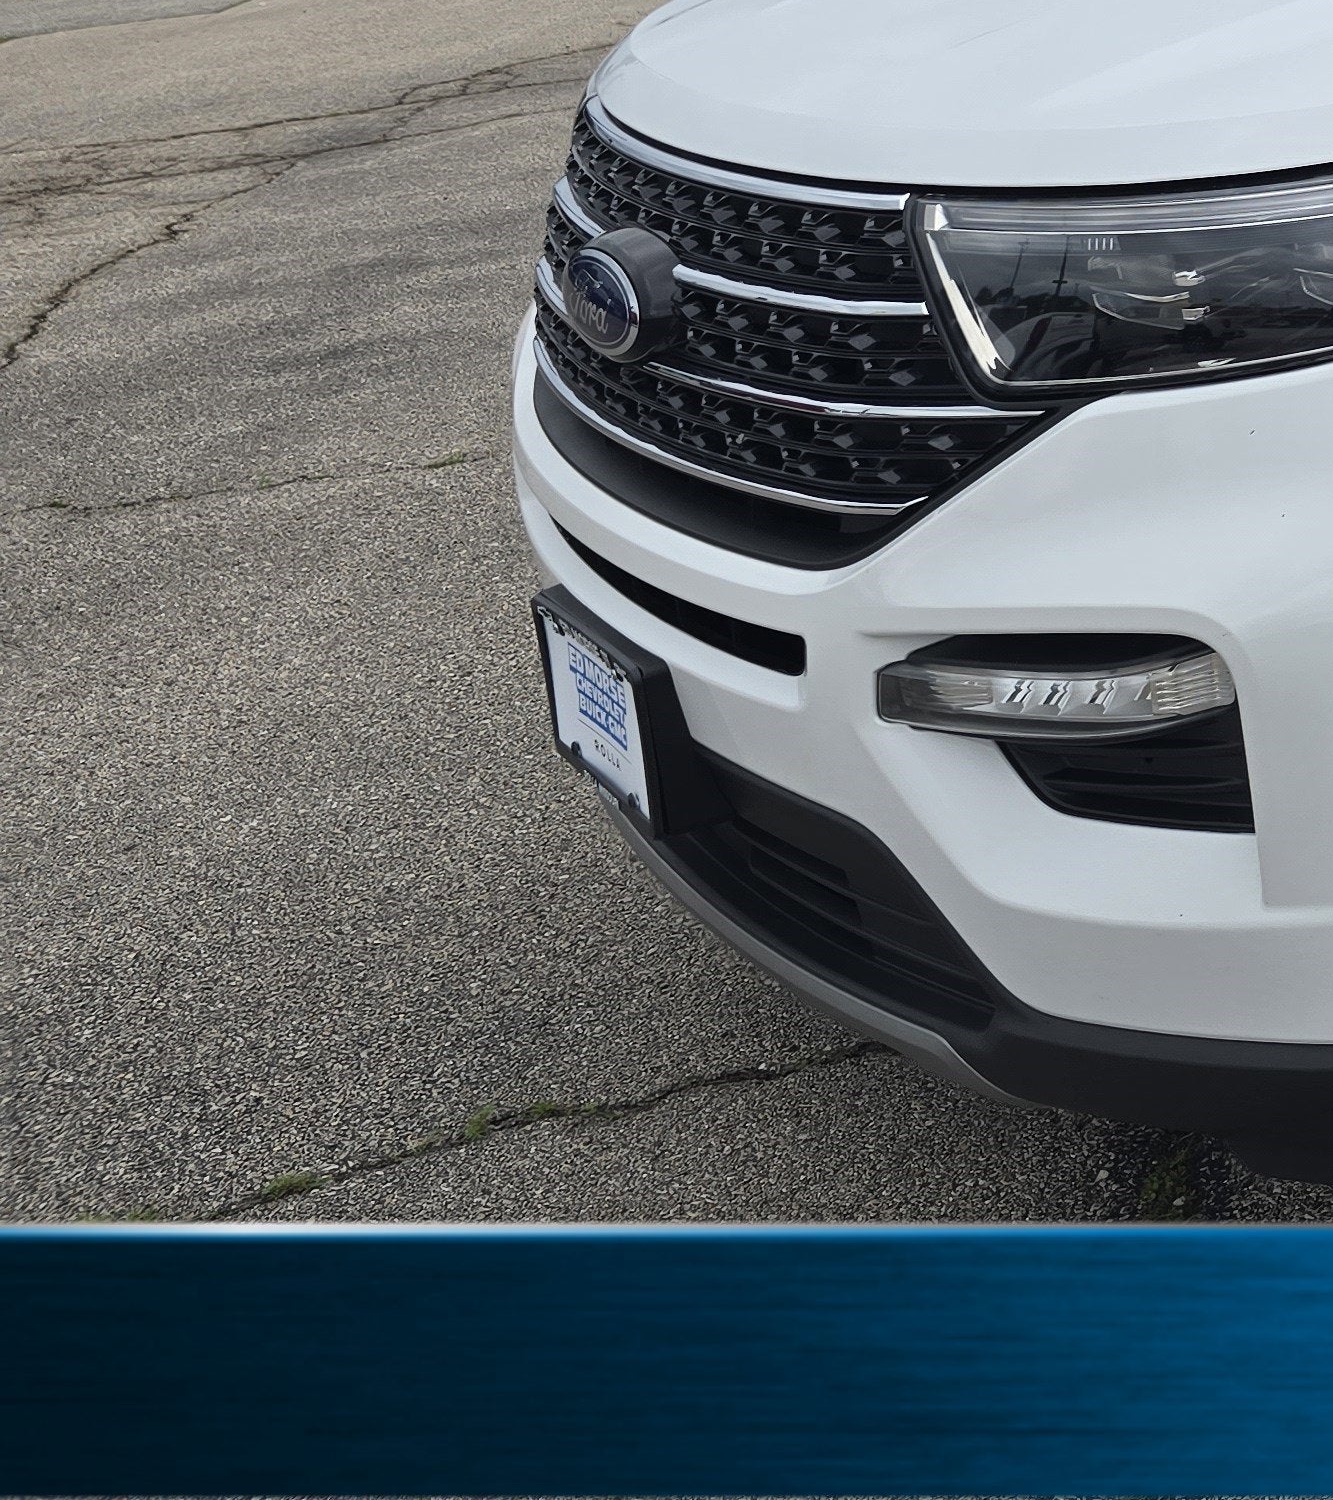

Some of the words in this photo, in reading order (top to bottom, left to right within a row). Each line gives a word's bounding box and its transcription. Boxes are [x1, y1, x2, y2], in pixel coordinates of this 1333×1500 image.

[568, 642, 585, 677] ED
[583, 654, 627, 715] MORSE
[579, 692, 608, 732] BUICK
